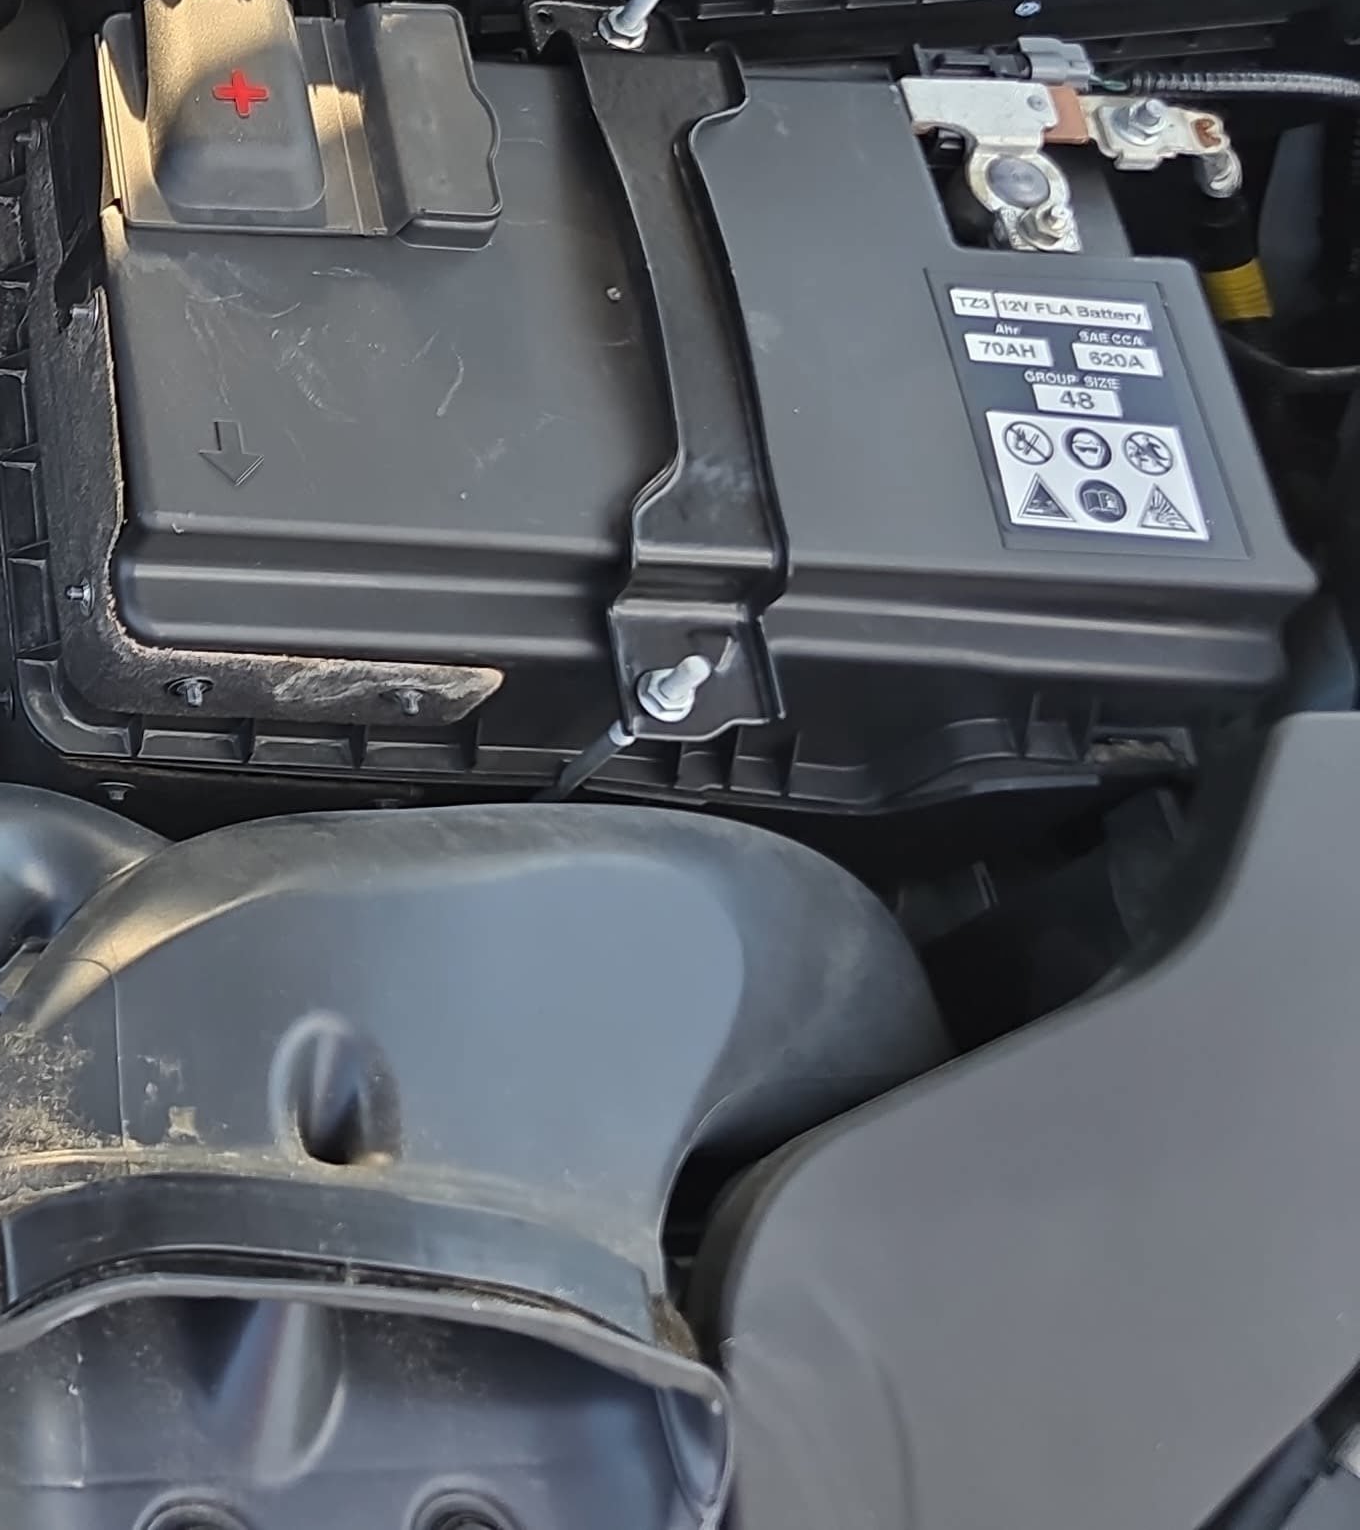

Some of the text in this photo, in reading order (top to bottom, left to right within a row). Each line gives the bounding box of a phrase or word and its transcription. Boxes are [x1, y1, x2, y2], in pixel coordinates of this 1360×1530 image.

[999, 299, 1142, 324] 12V FLA Battery
[995, 323, 1021, 335] Ahr
[1079, 330, 1109, 343] SAE
[978, 340, 1037, 359] 70AH
[1088, 351, 1145, 370] 620A
[1024, 370, 1121, 390] GROUP SIZE
[1060, 390, 1095, 410] 48
